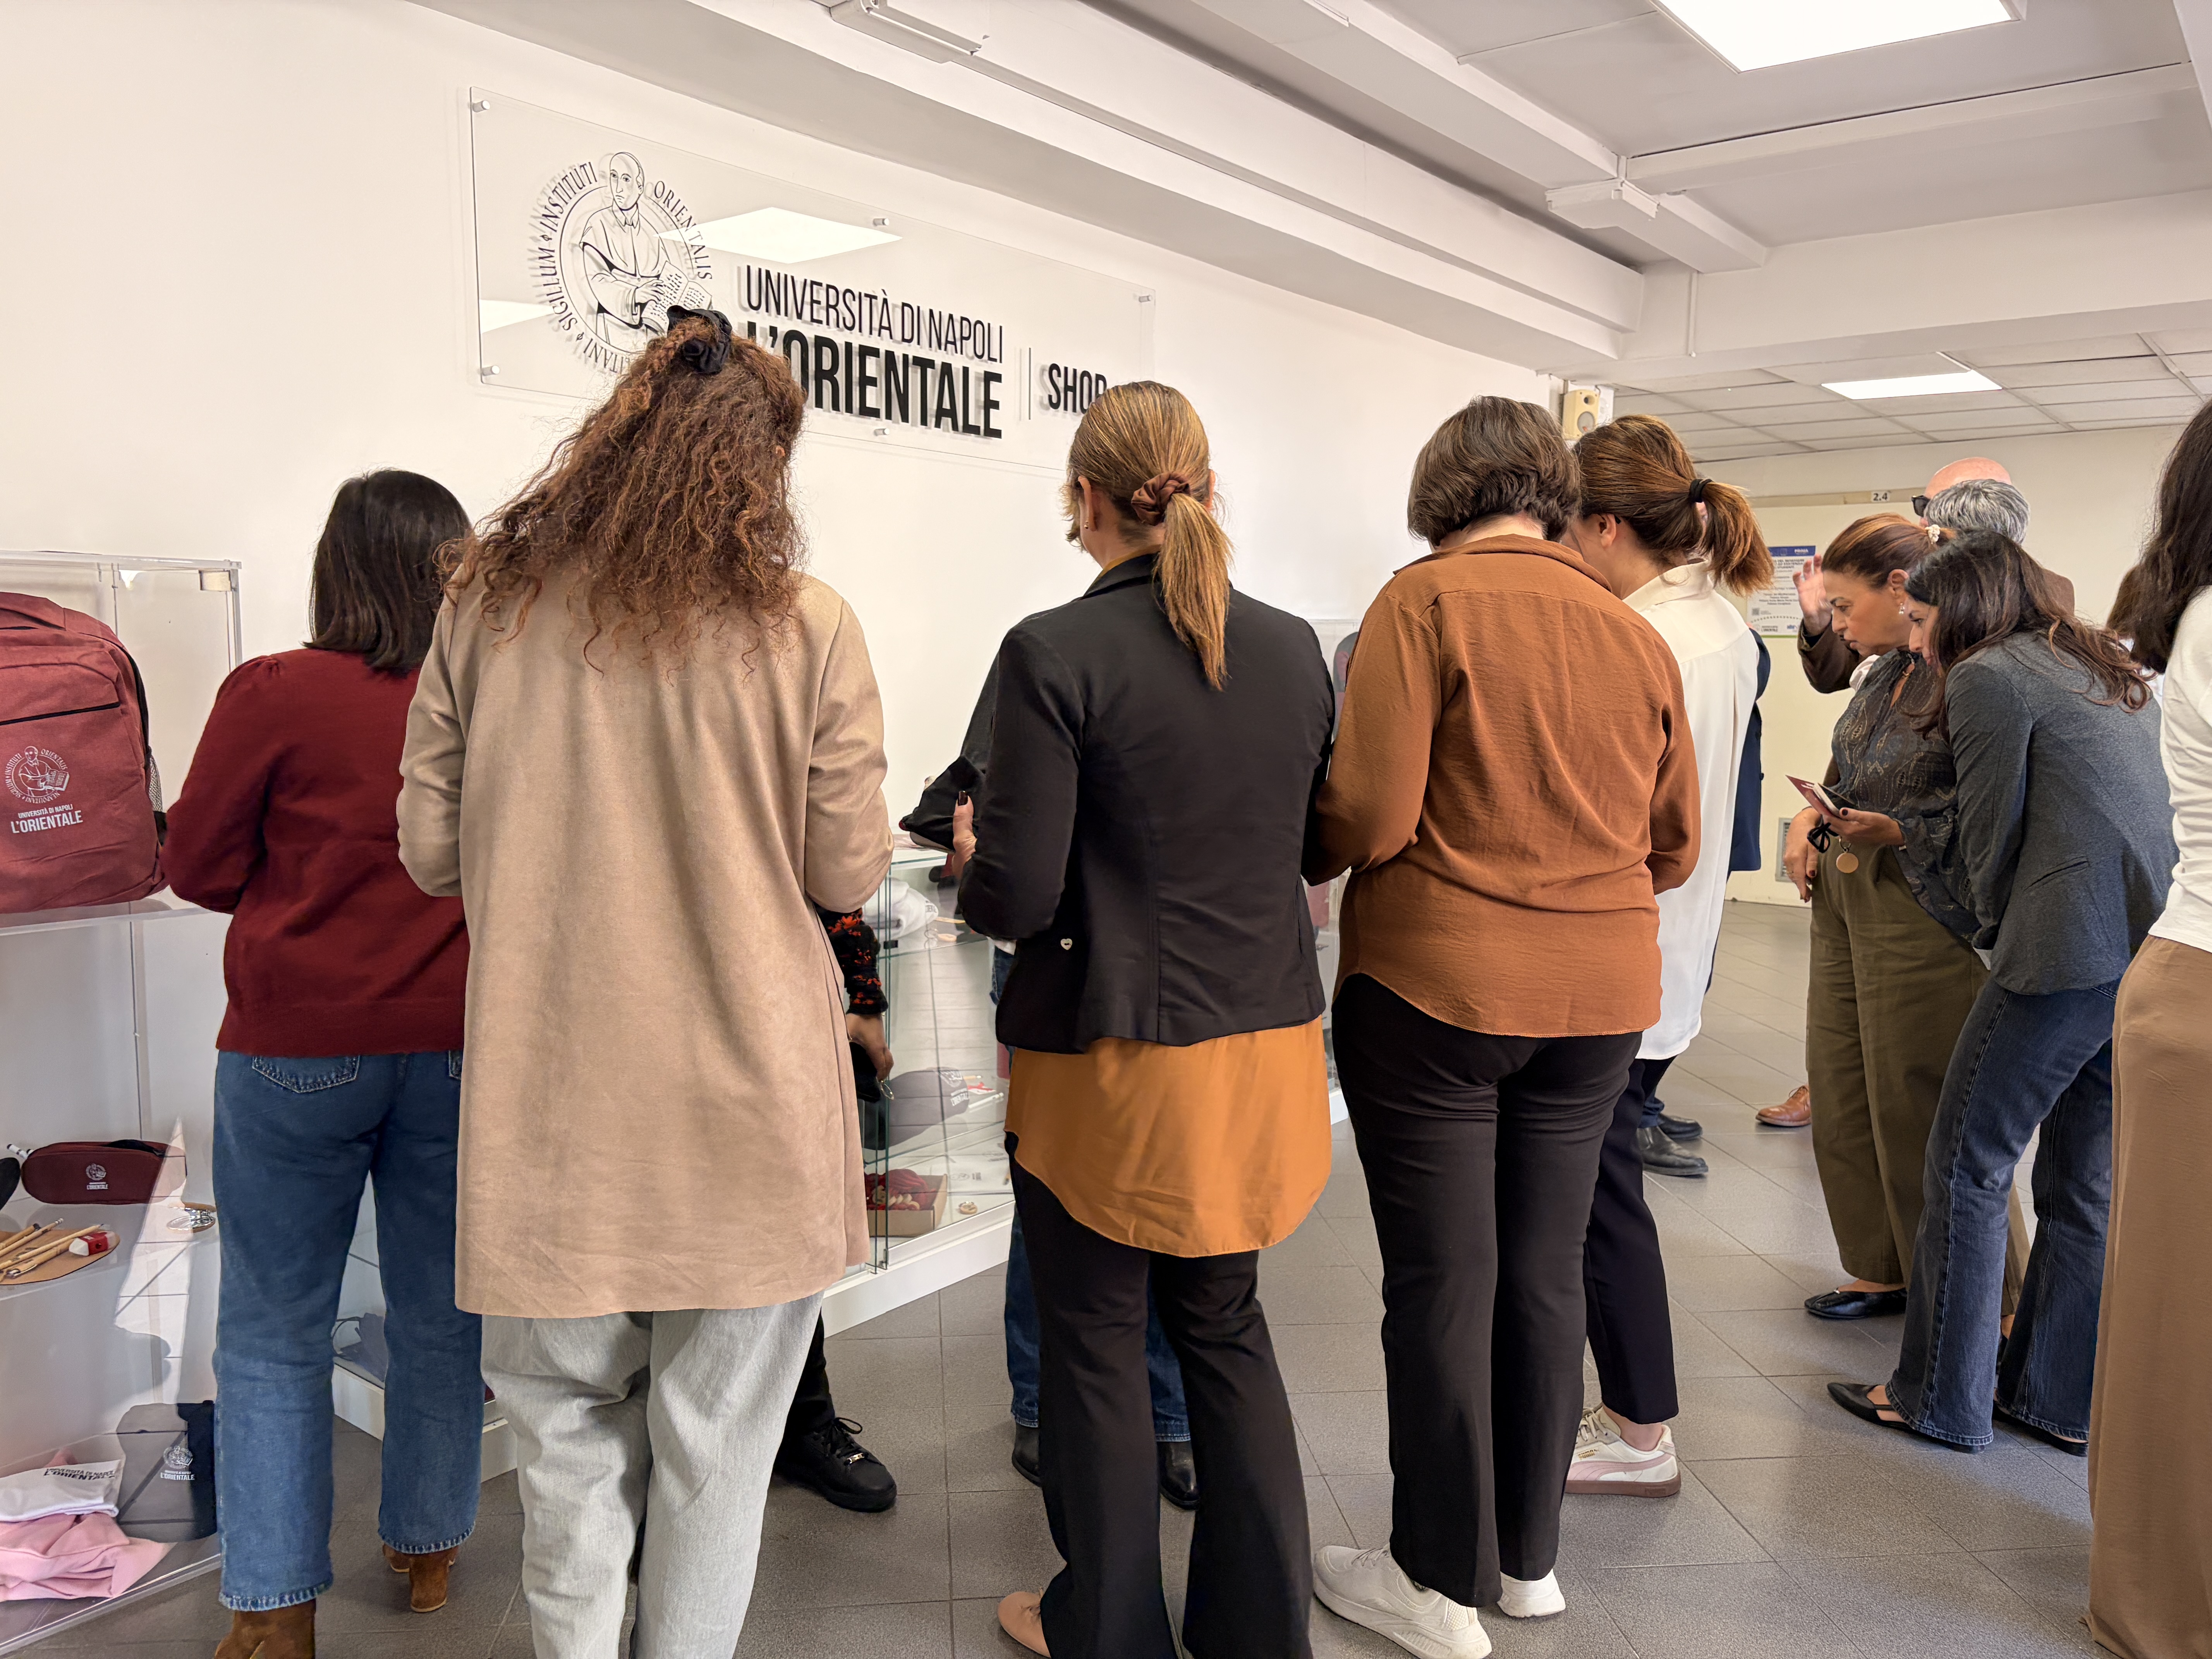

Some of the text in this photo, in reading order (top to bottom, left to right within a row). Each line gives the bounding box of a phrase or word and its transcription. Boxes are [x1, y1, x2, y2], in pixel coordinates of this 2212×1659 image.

[538, 161, 713, 331] SIGILLUM INSTITUTI ORIENTALIS
[747, 265, 1003, 364] UNIVERSITÀ DI NAPOLI
[1048, 363, 1107, 414] SHOP
[1873, 493, 1887, 501] 2.4
[10, 810, 83, 834] L'ORIENTALE
[55, 804, 74, 813] NAPOLI
